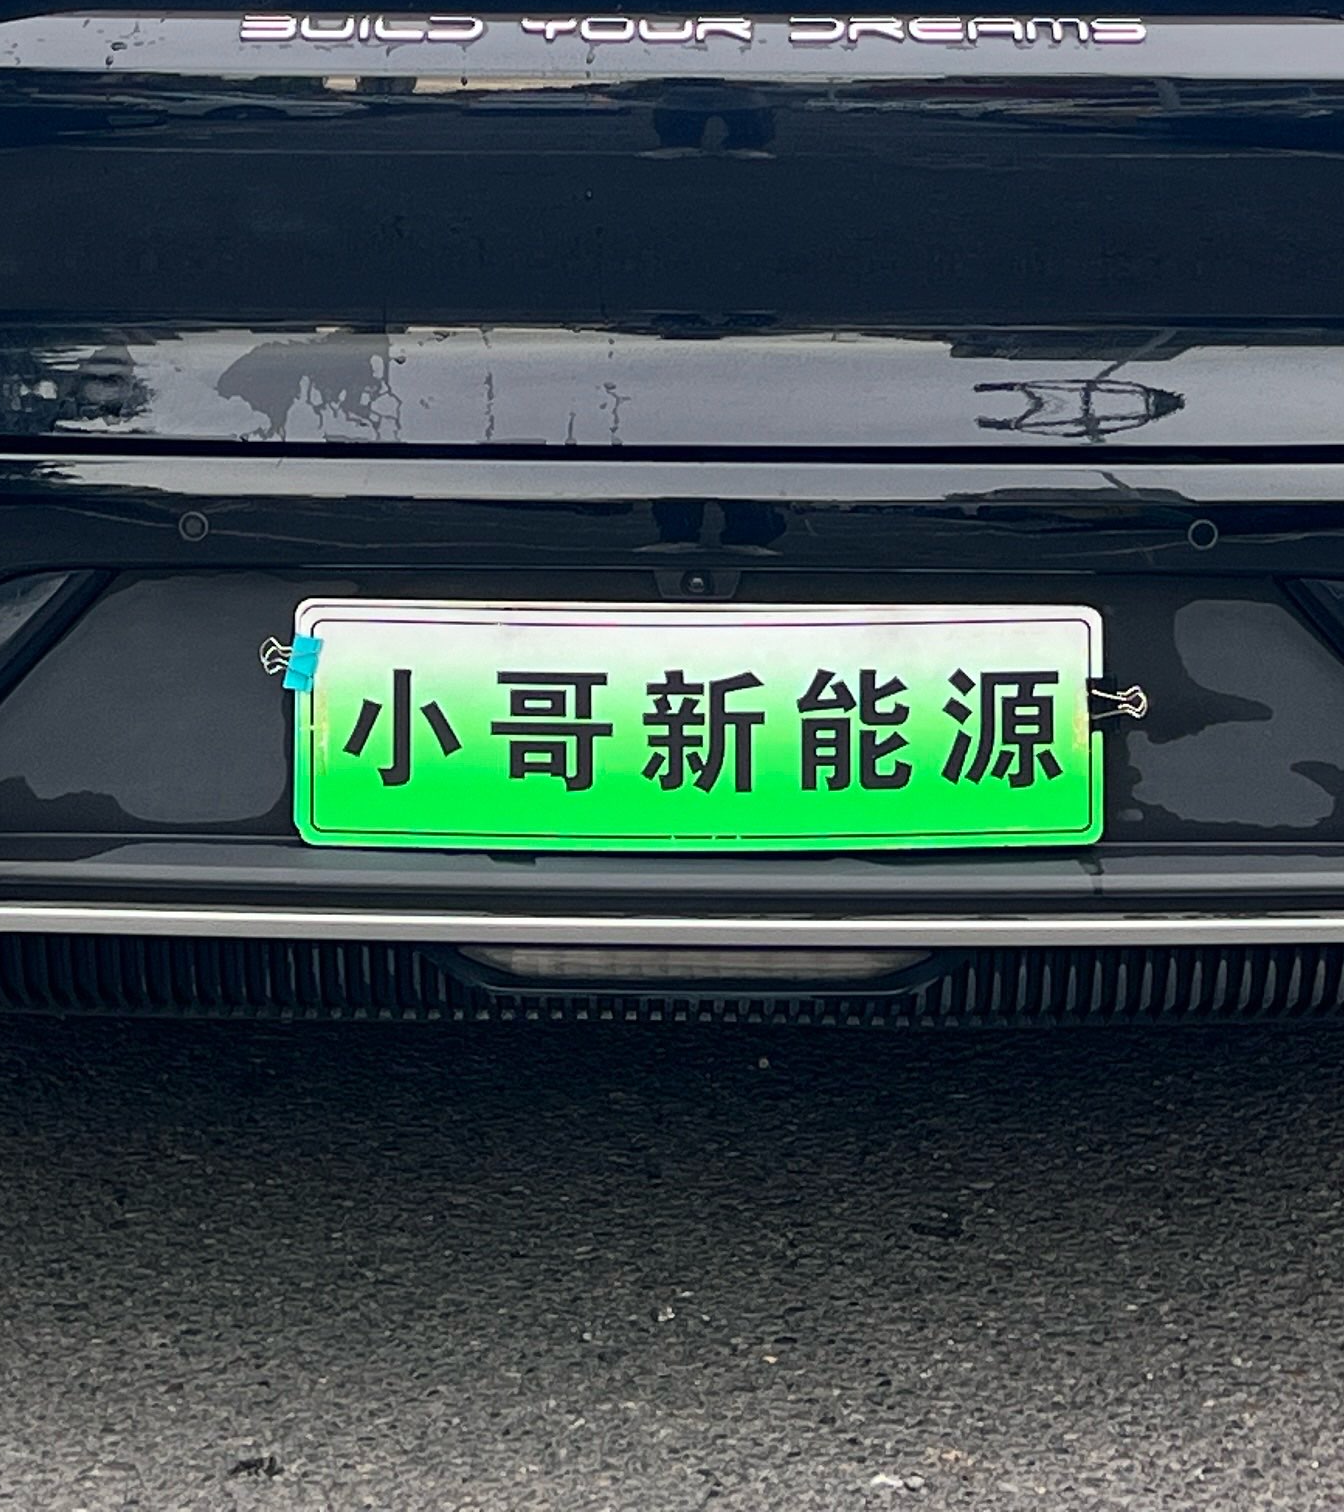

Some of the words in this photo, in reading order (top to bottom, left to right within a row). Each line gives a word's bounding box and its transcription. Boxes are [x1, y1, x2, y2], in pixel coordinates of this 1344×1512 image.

[240, 14, 485, 42] BUILD
[521, 16, 753, 42] YOUR
[788, 16, 1148, 45] DREAMS
[343, 668, 1066, 794] 小哥新能源
